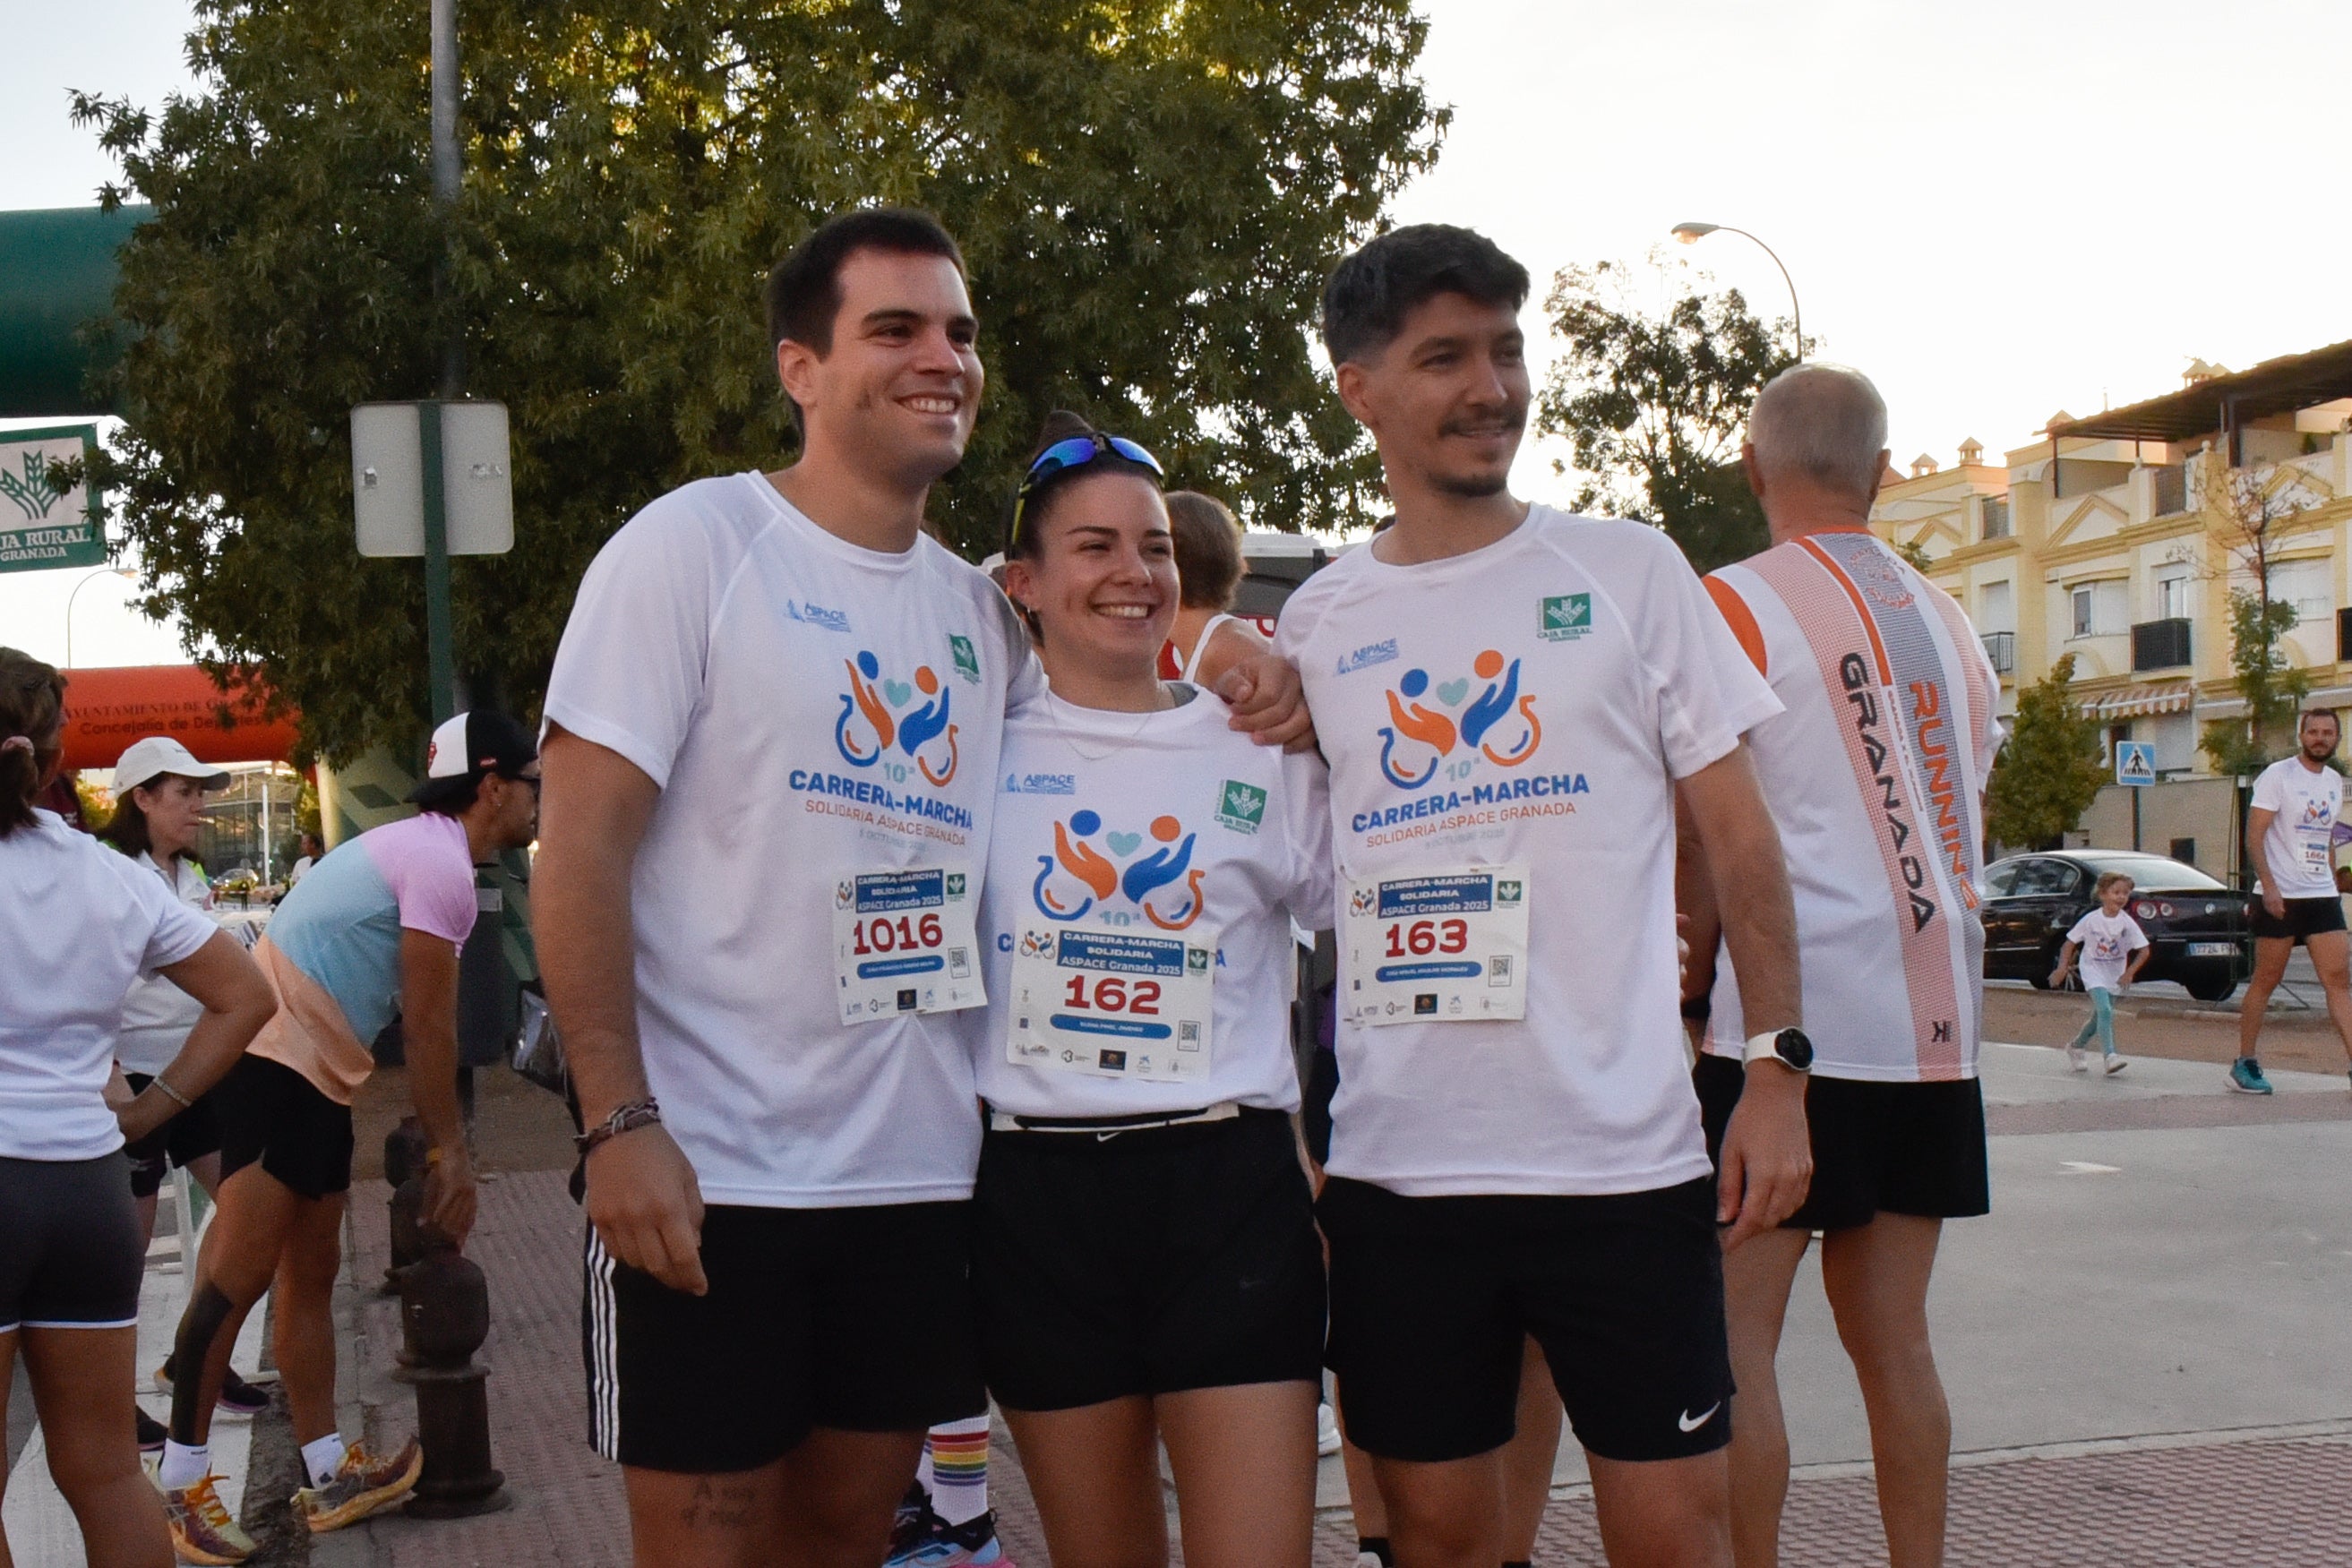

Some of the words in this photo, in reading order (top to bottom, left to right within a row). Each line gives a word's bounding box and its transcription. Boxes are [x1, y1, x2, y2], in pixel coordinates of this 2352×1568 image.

[0, 534, 21, 550] JA
[25, 527, 91, 547] RURAL
[1, 546, 68, 561] GRANADA
[169, 719, 188, 731] de
[788, 769, 974, 831] CARRERA-MARCHA
[1351, 773, 1591, 834] CARRERA-MARCHA
[1840, 652, 1936, 936] GRANADA
[804, 799, 874, 825] SOLIDARIA
[877, 814, 923, 836] ASPACE
[923, 825, 966, 847] GRANADA
[1366, 822, 1437, 849] SOLIDARIA
[1438, 810, 1496, 832] ASPACE
[1499, 801, 1577, 822] GRANADA
[856, 870, 940, 887] CARRERA-MARCHA
[1381, 876, 1489, 892] CARRERA-MARCHA
[871, 884, 918, 896] SOLIDARIA
[1399, 889, 1461, 901] SOLIDARIA
[857, 899, 886, 912] ASPACE
[886, 897, 921, 910] Granada
[922, 895, 942, 906] 2025
[1380, 904, 1417, 918] ASPACE
[1418, 901, 1462, 913] Granada
[1464, 900, 1489, 912] 2025
[854, 913, 943, 955] 1016
[1062, 932, 1182, 951] CARRERA-MARCHA
[1385, 918, 1468, 958] 163
[1086, 946, 1155, 960] SOLIDARIA
[1060, 955, 1107, 970] ASPACE
[1109, 961, 1155, 975] Granada
[1156, 964, 1181, 976] 2025
[1064, 974, 1162, 1015] 162
